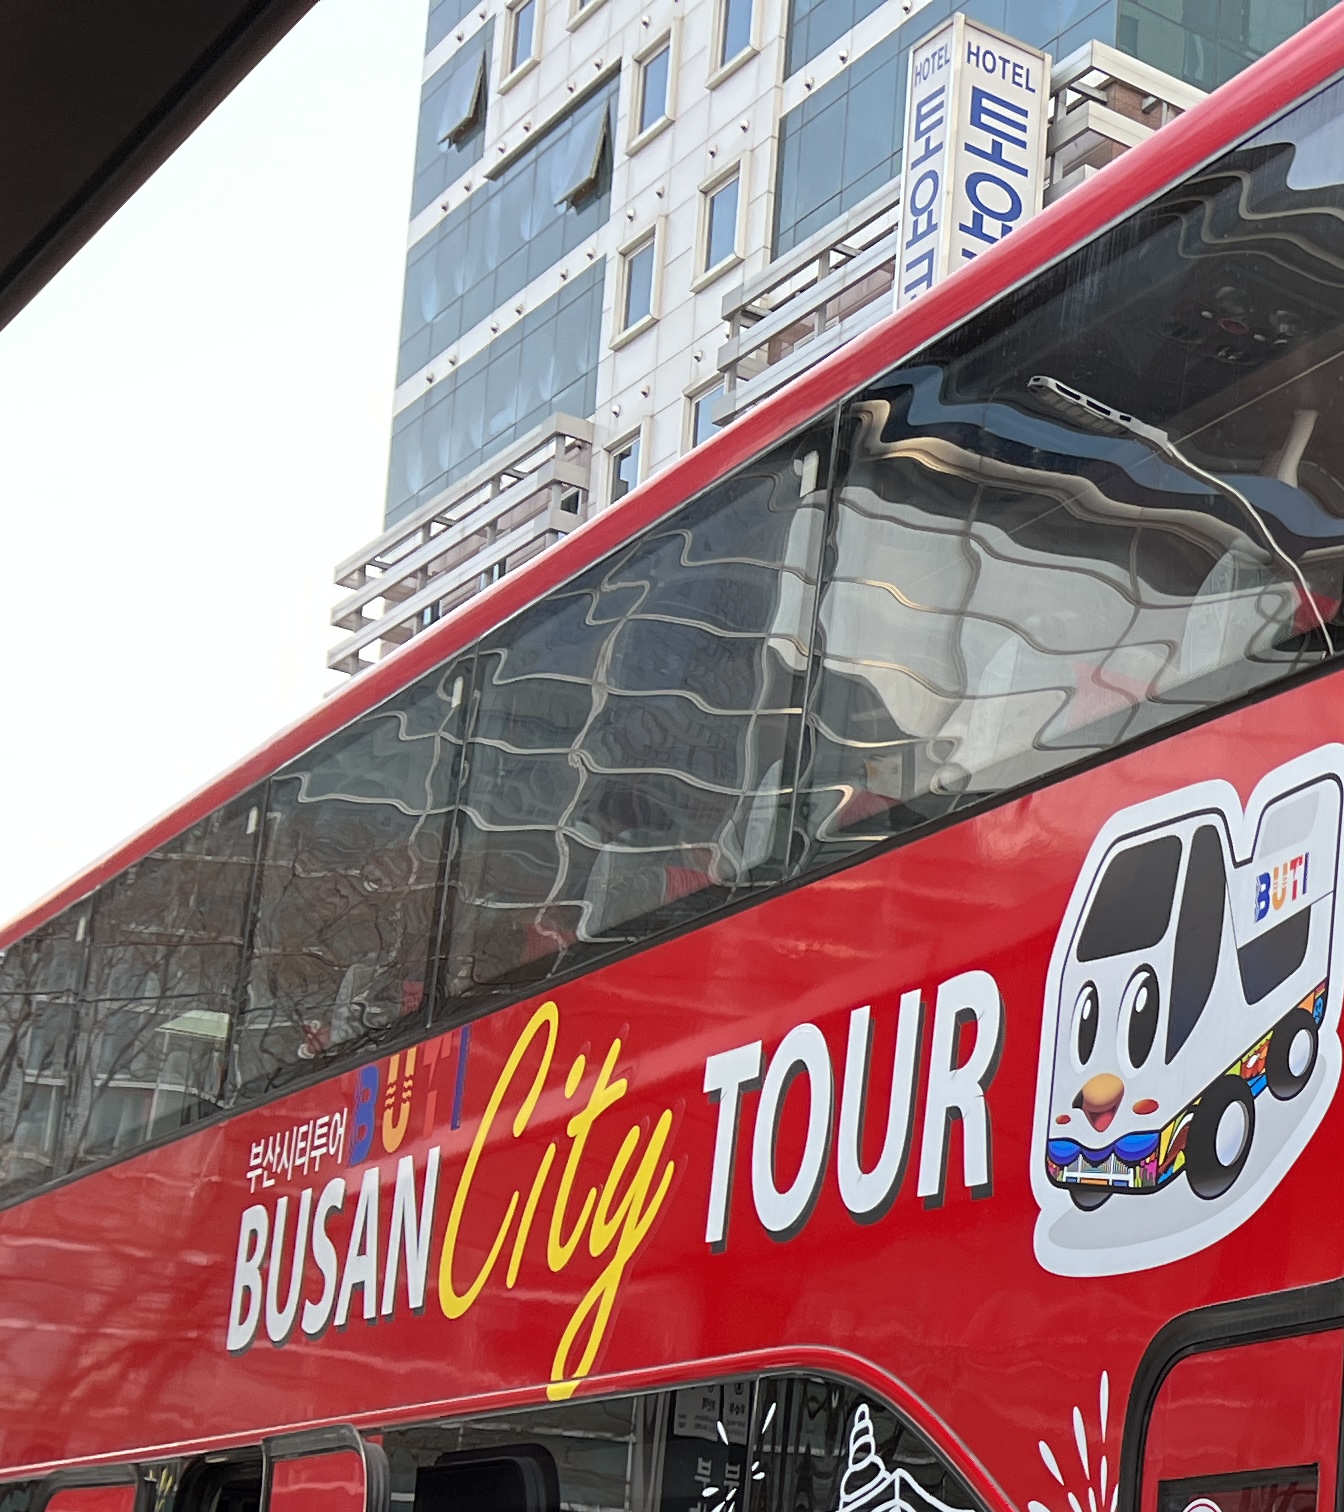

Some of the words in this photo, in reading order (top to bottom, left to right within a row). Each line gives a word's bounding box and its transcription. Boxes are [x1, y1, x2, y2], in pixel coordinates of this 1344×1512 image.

[914, 43, 950, 88] HOTEL
[966, 41, 1036, 94] HOTEL
[1254, 851, 1312, 923] BUTI
[247, 1106, 348, 1192] 부산시티투어
[226, 1146, 440, 1356] BUSAN
[438, 1001, 674, 1402] City
[704, 970, 1006, 1250] TOUR
